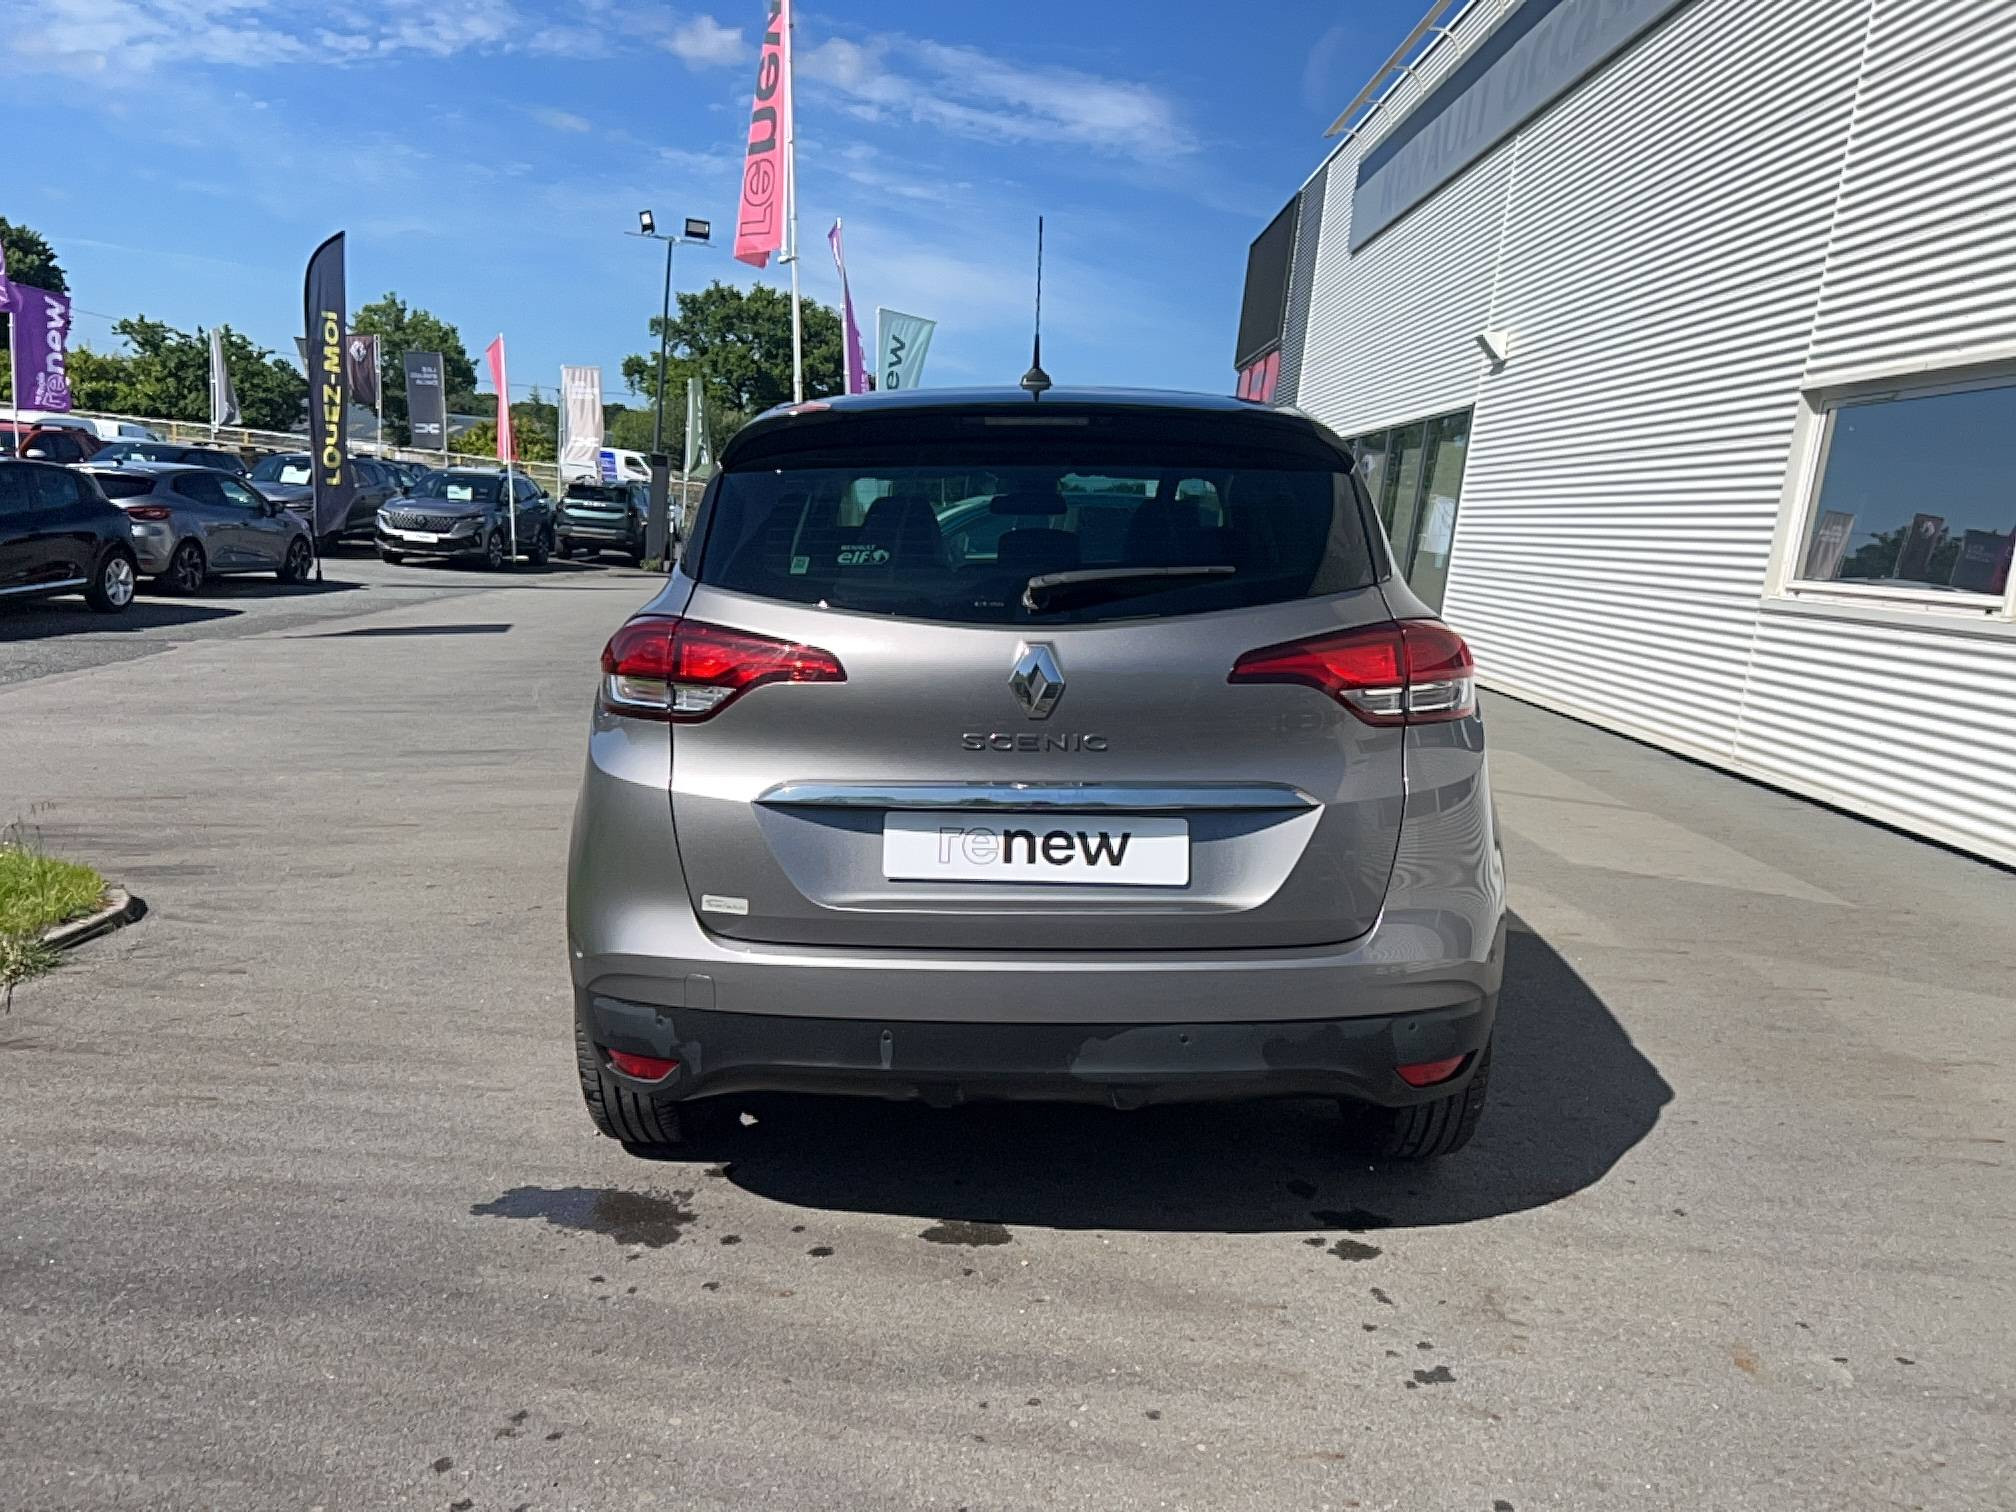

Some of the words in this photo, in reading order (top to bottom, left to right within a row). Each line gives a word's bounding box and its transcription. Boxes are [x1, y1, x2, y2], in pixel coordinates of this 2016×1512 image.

[42, 295, 67, 409] renew
[321, 311, 342, 486] LOUEZ-MOI
[837, 551, 870, 564] elf
[961, 732, 1108, 752] SCENIC
[938, 826, 1132, 867] renew
